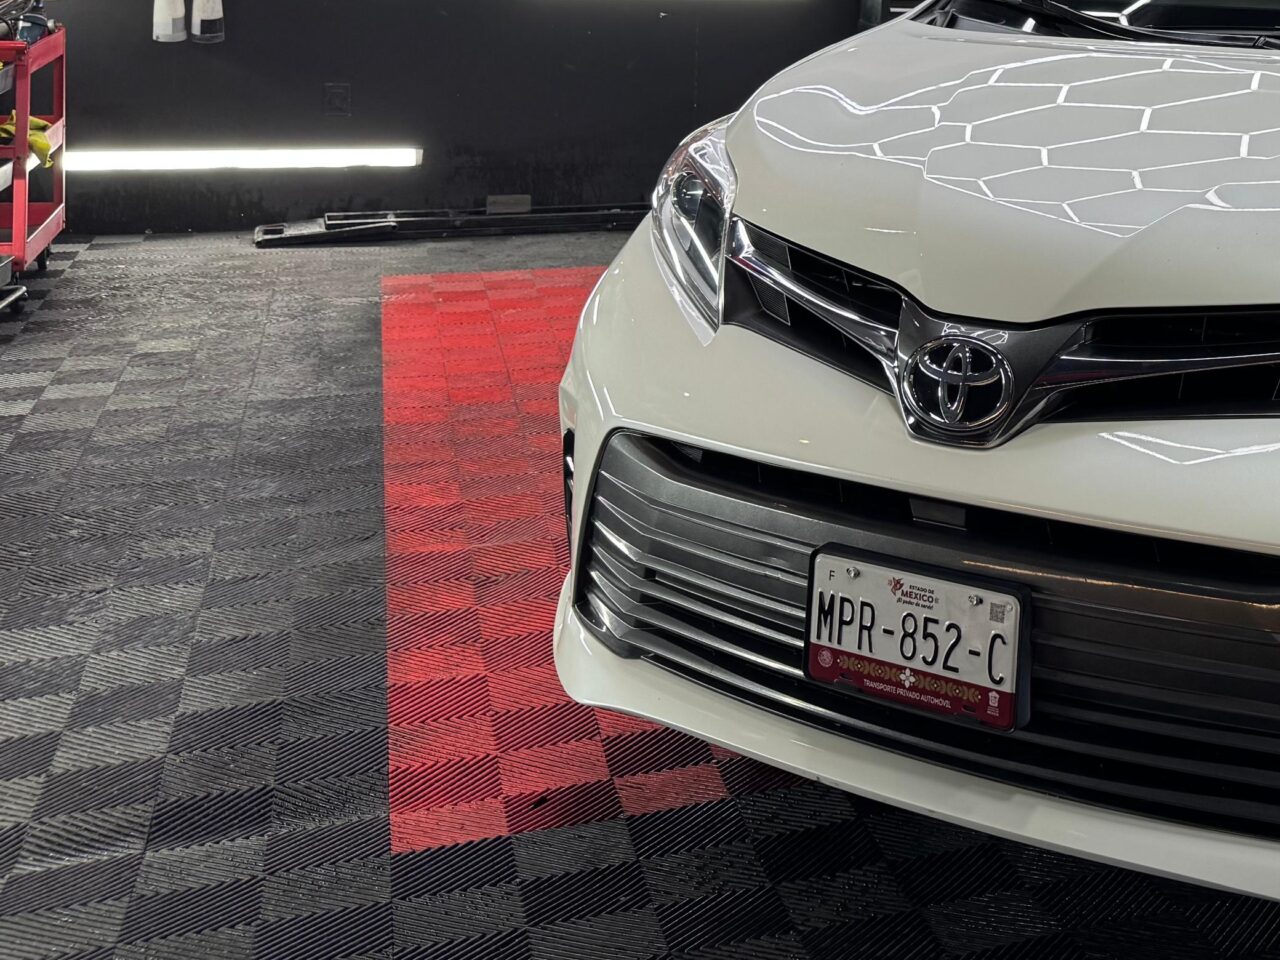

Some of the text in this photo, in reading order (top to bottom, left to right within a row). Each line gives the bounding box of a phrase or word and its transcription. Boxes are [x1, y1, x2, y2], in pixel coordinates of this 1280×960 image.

[829, 570, 836, 581] F
[816, 589, 1007, 685] MPR-852-C
[864, 678, 897, 694] TRANSPORTE
[897, 688, 920, 701] PRIVADO
